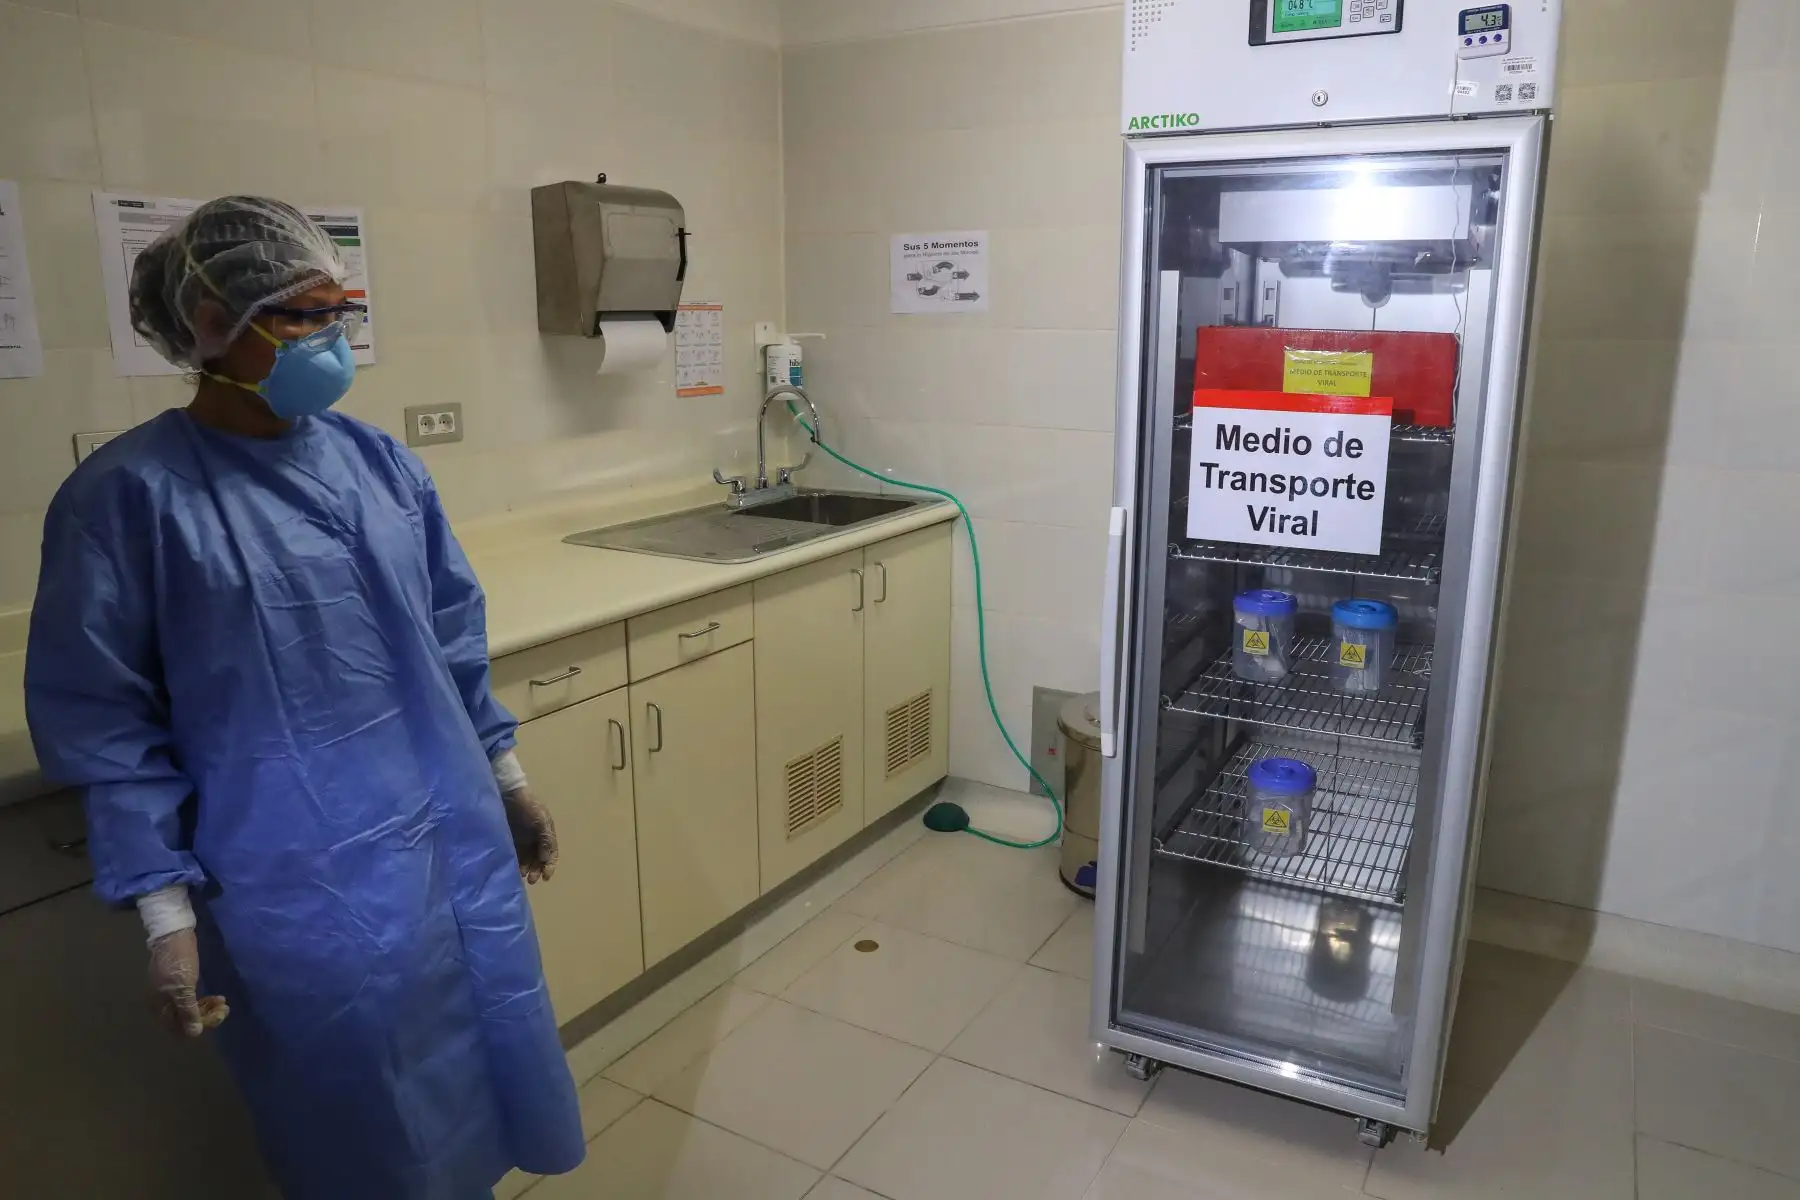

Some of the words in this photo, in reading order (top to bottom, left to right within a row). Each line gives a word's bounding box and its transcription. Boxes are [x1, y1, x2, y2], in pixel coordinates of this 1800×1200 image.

[1481, 14, 1496, 26] 4.3
[1128, 113, 1200, 130] ARCTIKO
[903, 243, 920, 251] Sus
[923, 242, 929, 250] 5
[931, 241, 979, 249] Momentos
[1289, 368, 1312, 376] MEDIO
[1324, 370, 1367, 378] TRANSPORTE
[1317, 379, 1337, 387] VIRAL
[1215, 423, 1313, 456] Medio
[1323, 430, 1364, 459] de
[1199, 461, 1376, 502] Transporte
[1246, 504, 1319, 537] Viral
